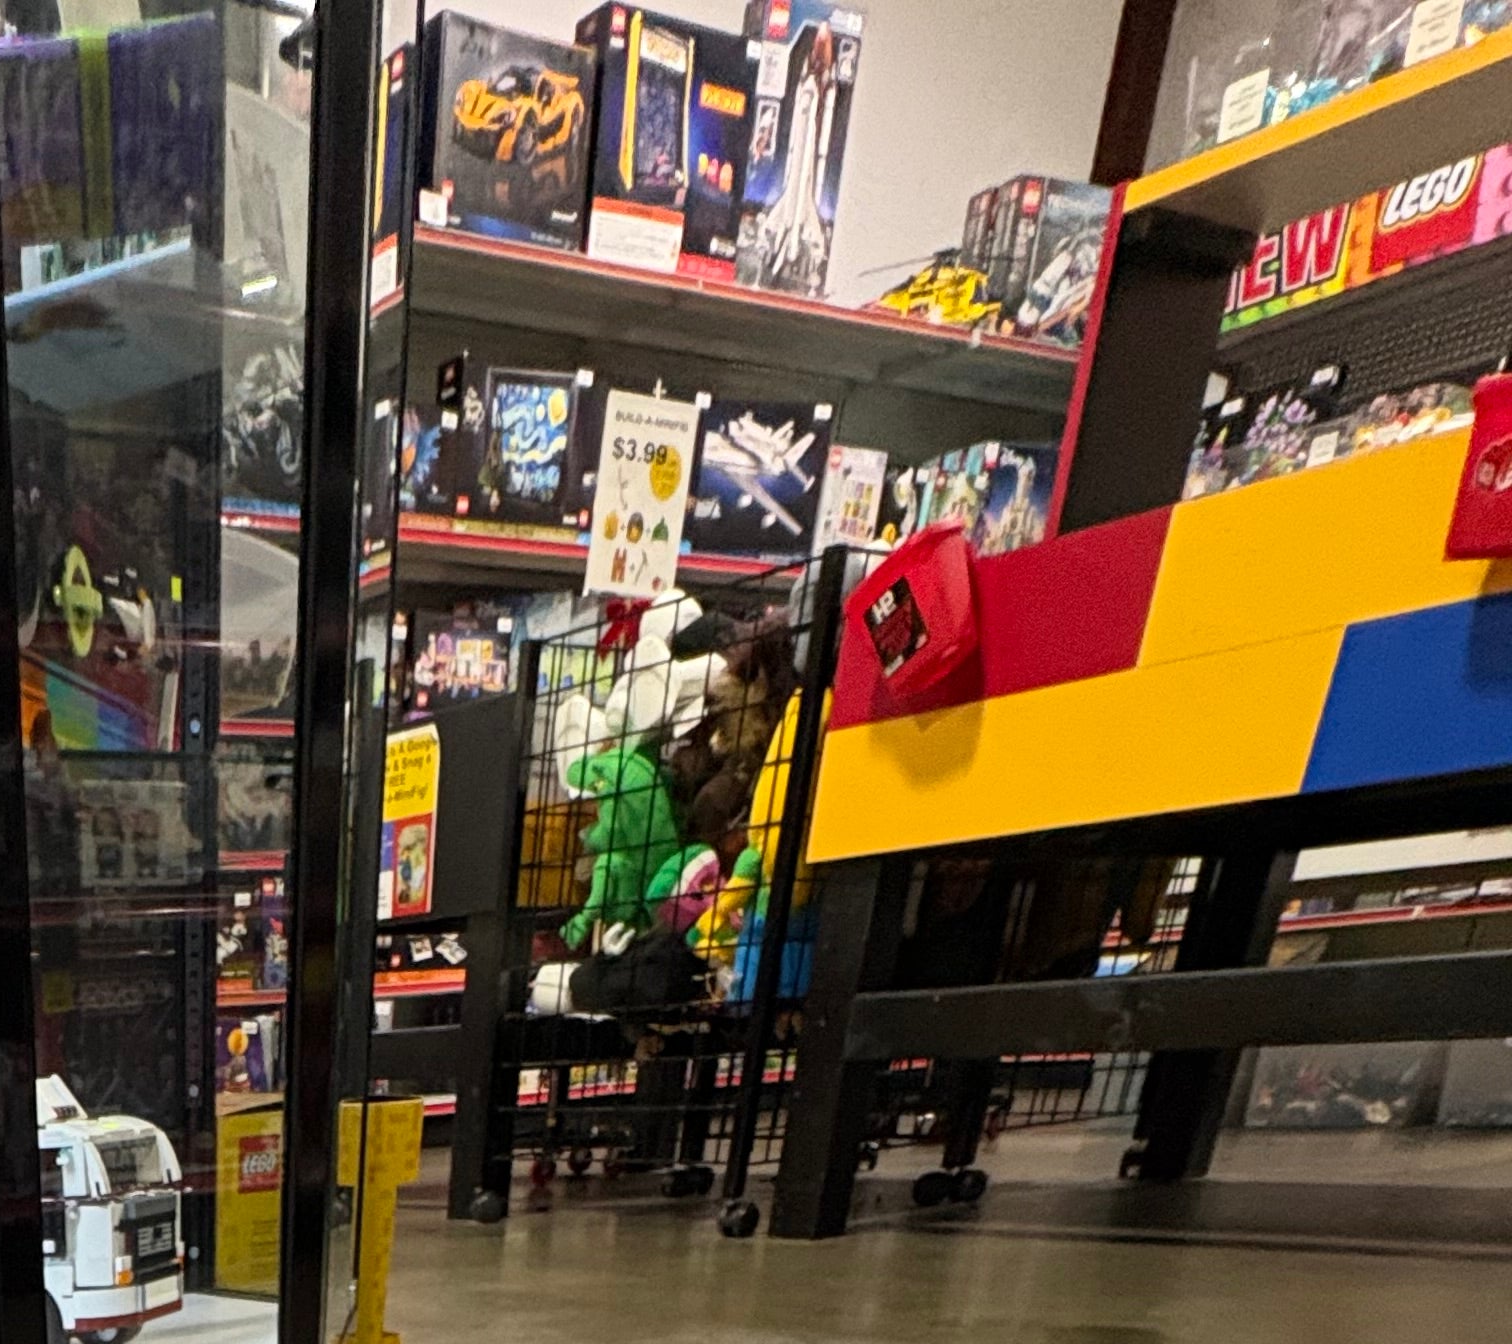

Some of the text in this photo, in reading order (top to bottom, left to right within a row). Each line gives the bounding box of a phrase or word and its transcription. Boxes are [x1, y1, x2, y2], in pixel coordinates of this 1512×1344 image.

[1382, 154, 1477, 227] LEGO
[612, 435, 668, 465] $3.99
[243, 1153, 276, 1175] LEGO
